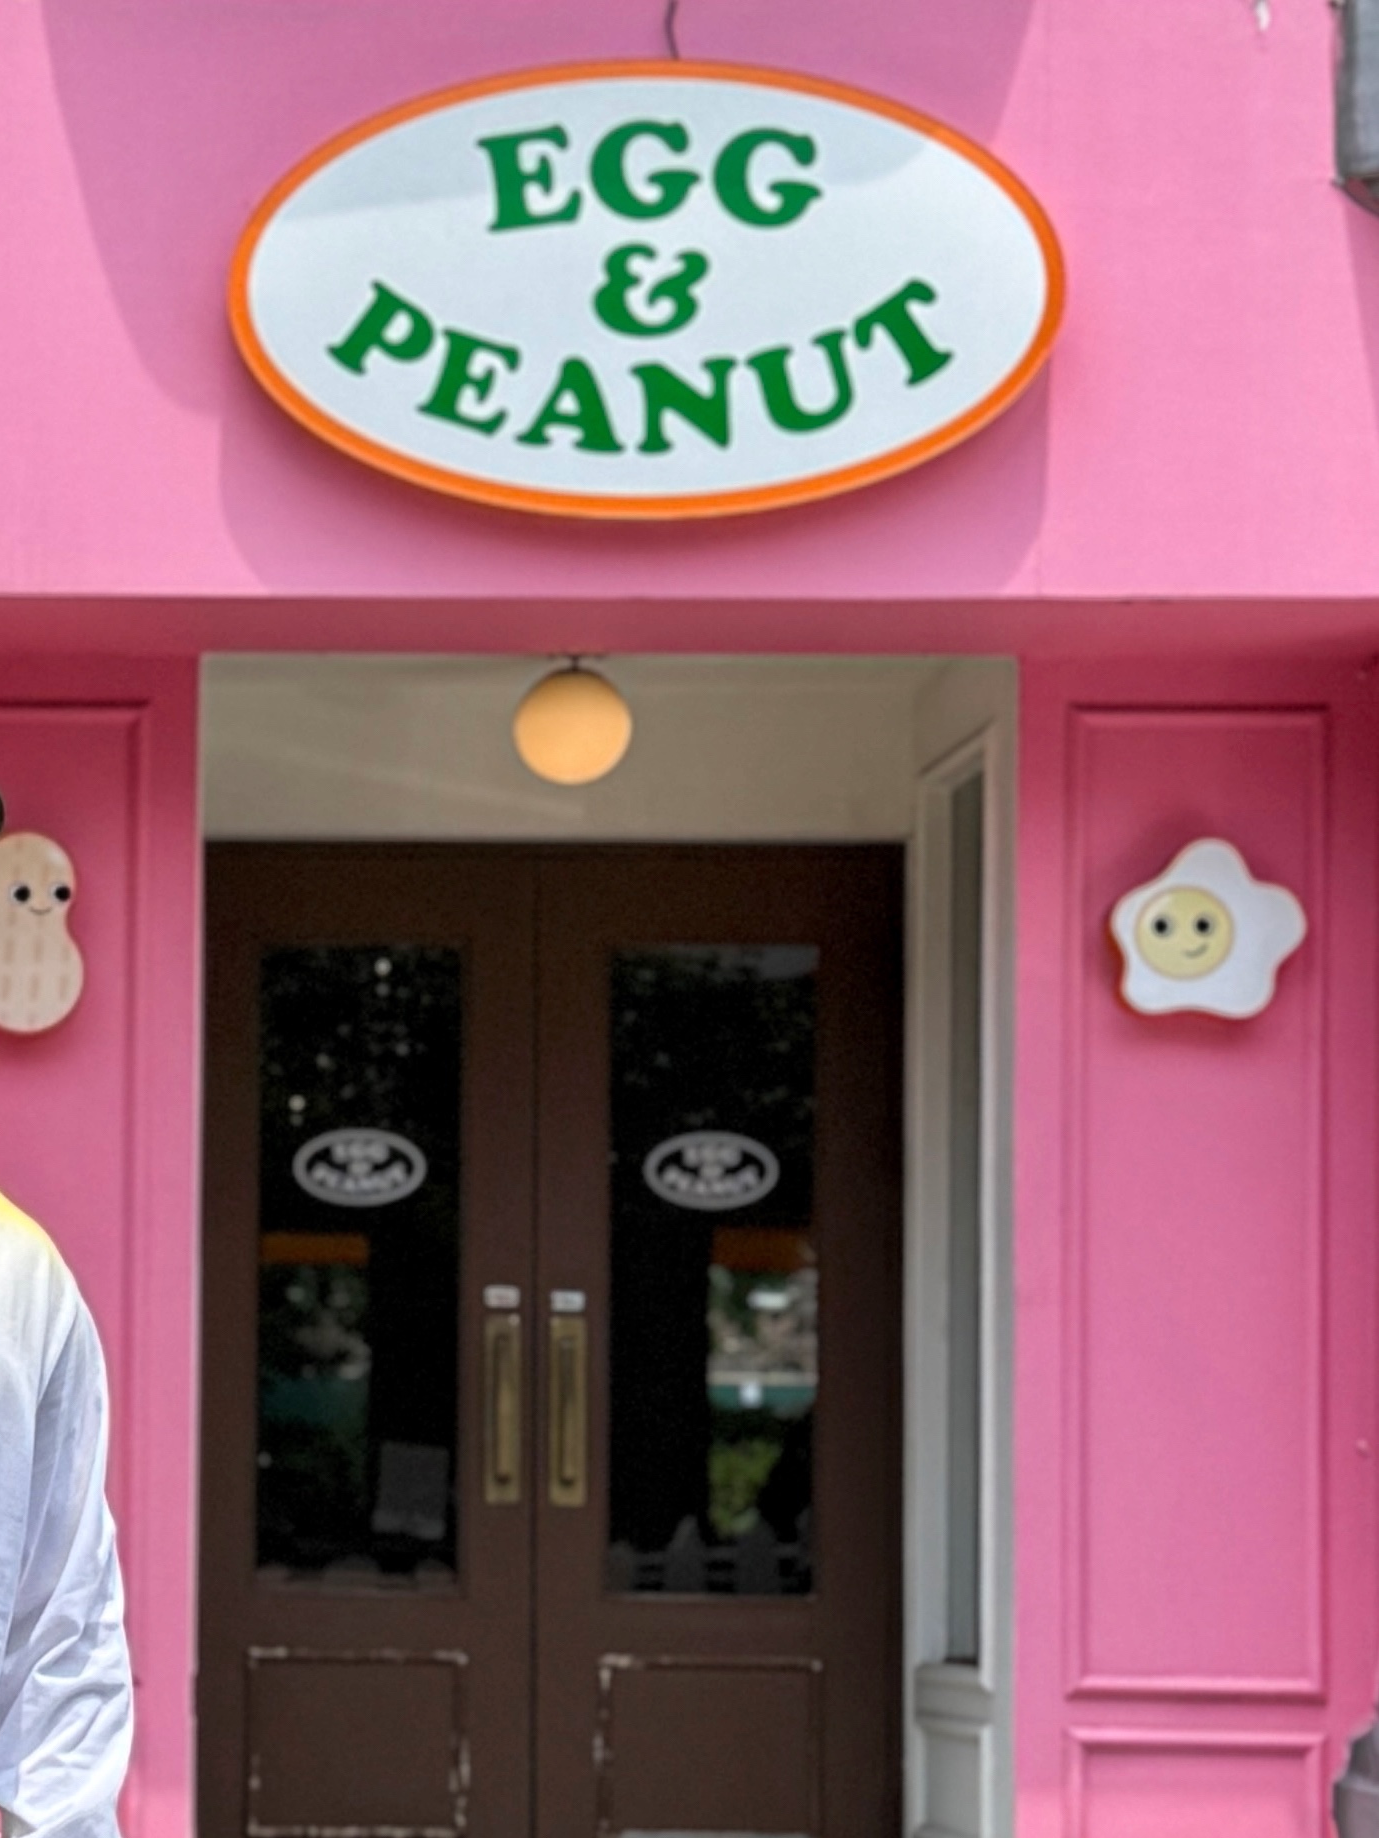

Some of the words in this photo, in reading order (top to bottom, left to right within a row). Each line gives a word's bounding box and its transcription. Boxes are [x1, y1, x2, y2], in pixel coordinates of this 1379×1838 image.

[478, 120, 821, 233] EGG
[592, 243, 710, 338] &
[327, 277, 954, 455] PEANUT
